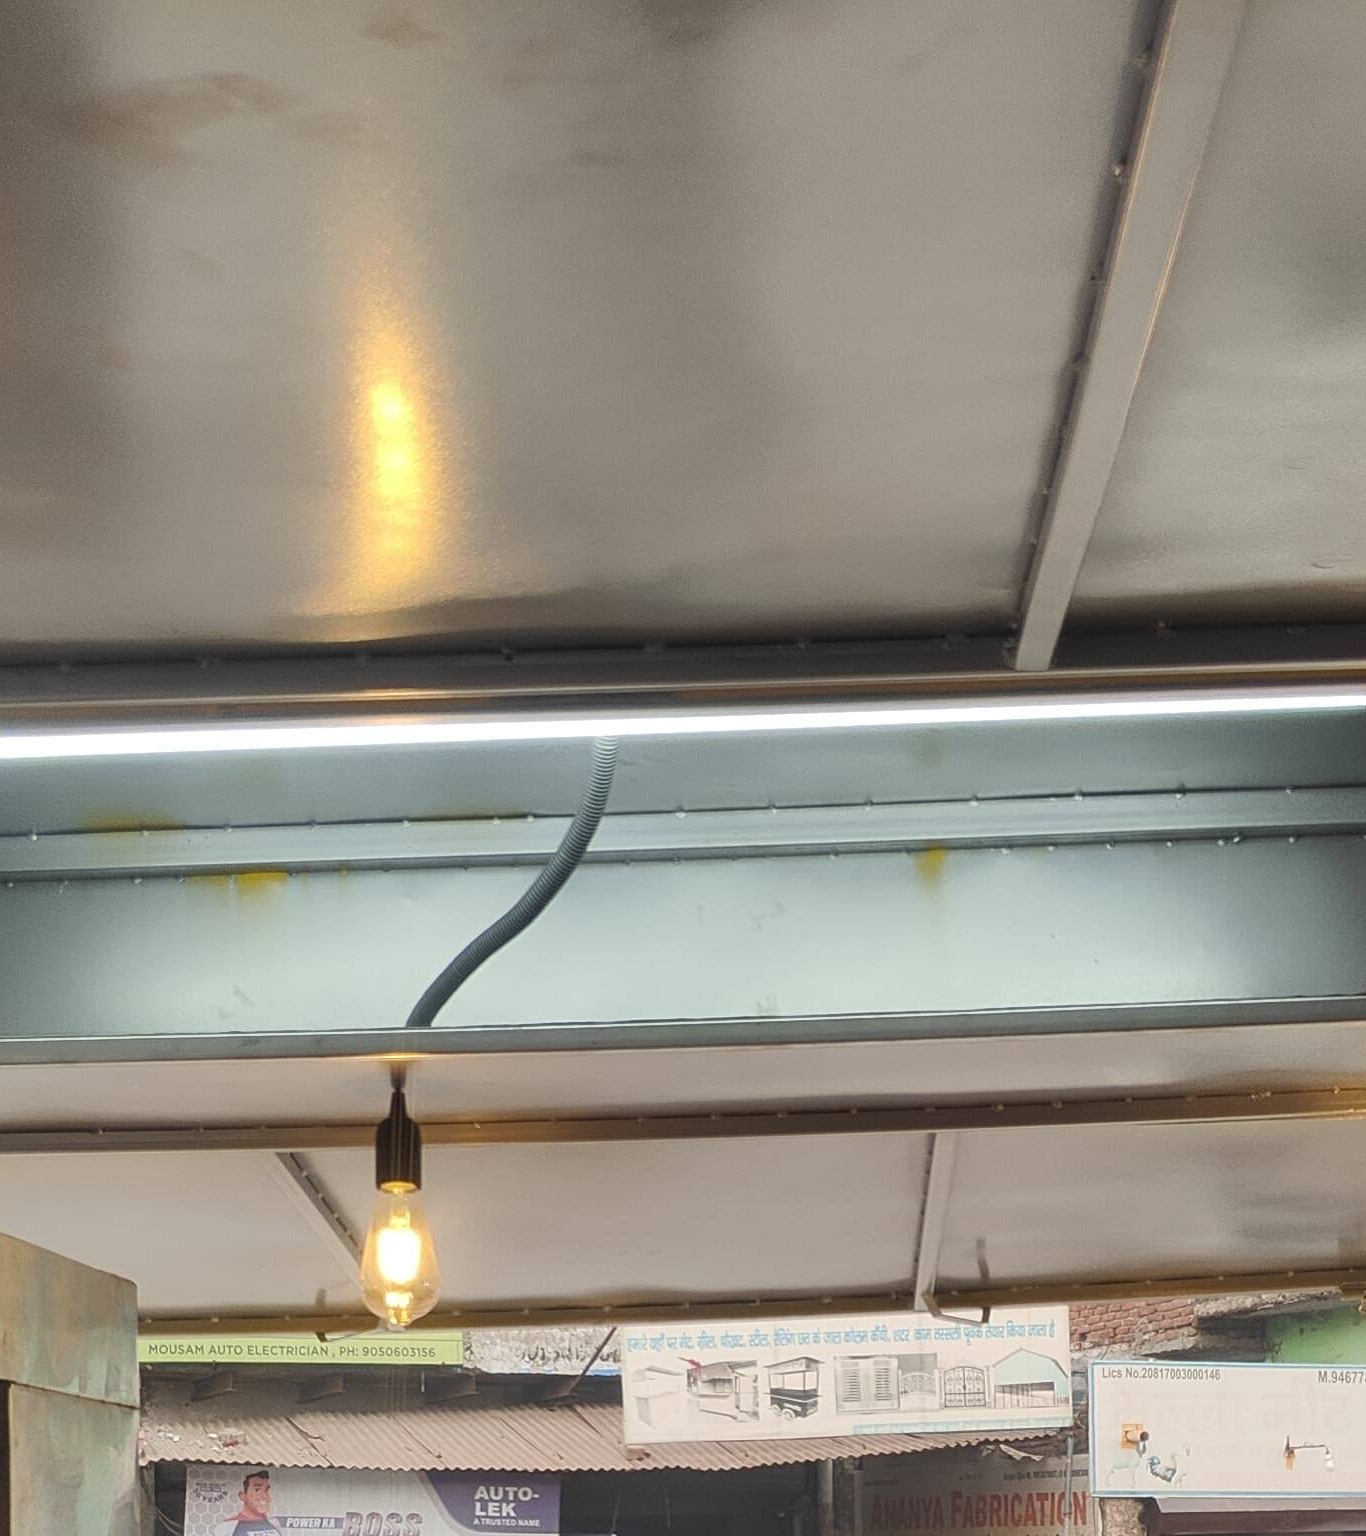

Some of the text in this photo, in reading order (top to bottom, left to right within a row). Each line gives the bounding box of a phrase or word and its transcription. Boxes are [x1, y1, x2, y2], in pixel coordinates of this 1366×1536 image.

[148, 1344, 436, 1358] MOUSAM AUTO ELECTRICIAN PH: 9050603156
[1101, 1368, 1123, 1380] Lics
[474, 1485, 540, 1501] AUTO-
[474, 1502, 516, 1517] LEK
[869, 1493, 944, 1530] ANANYA
[286, 1518, 336, 1528] POWER KA
[480, 1518, 516, 1527] TRUSTED
[518, 1519, 541, 1528] NAME
